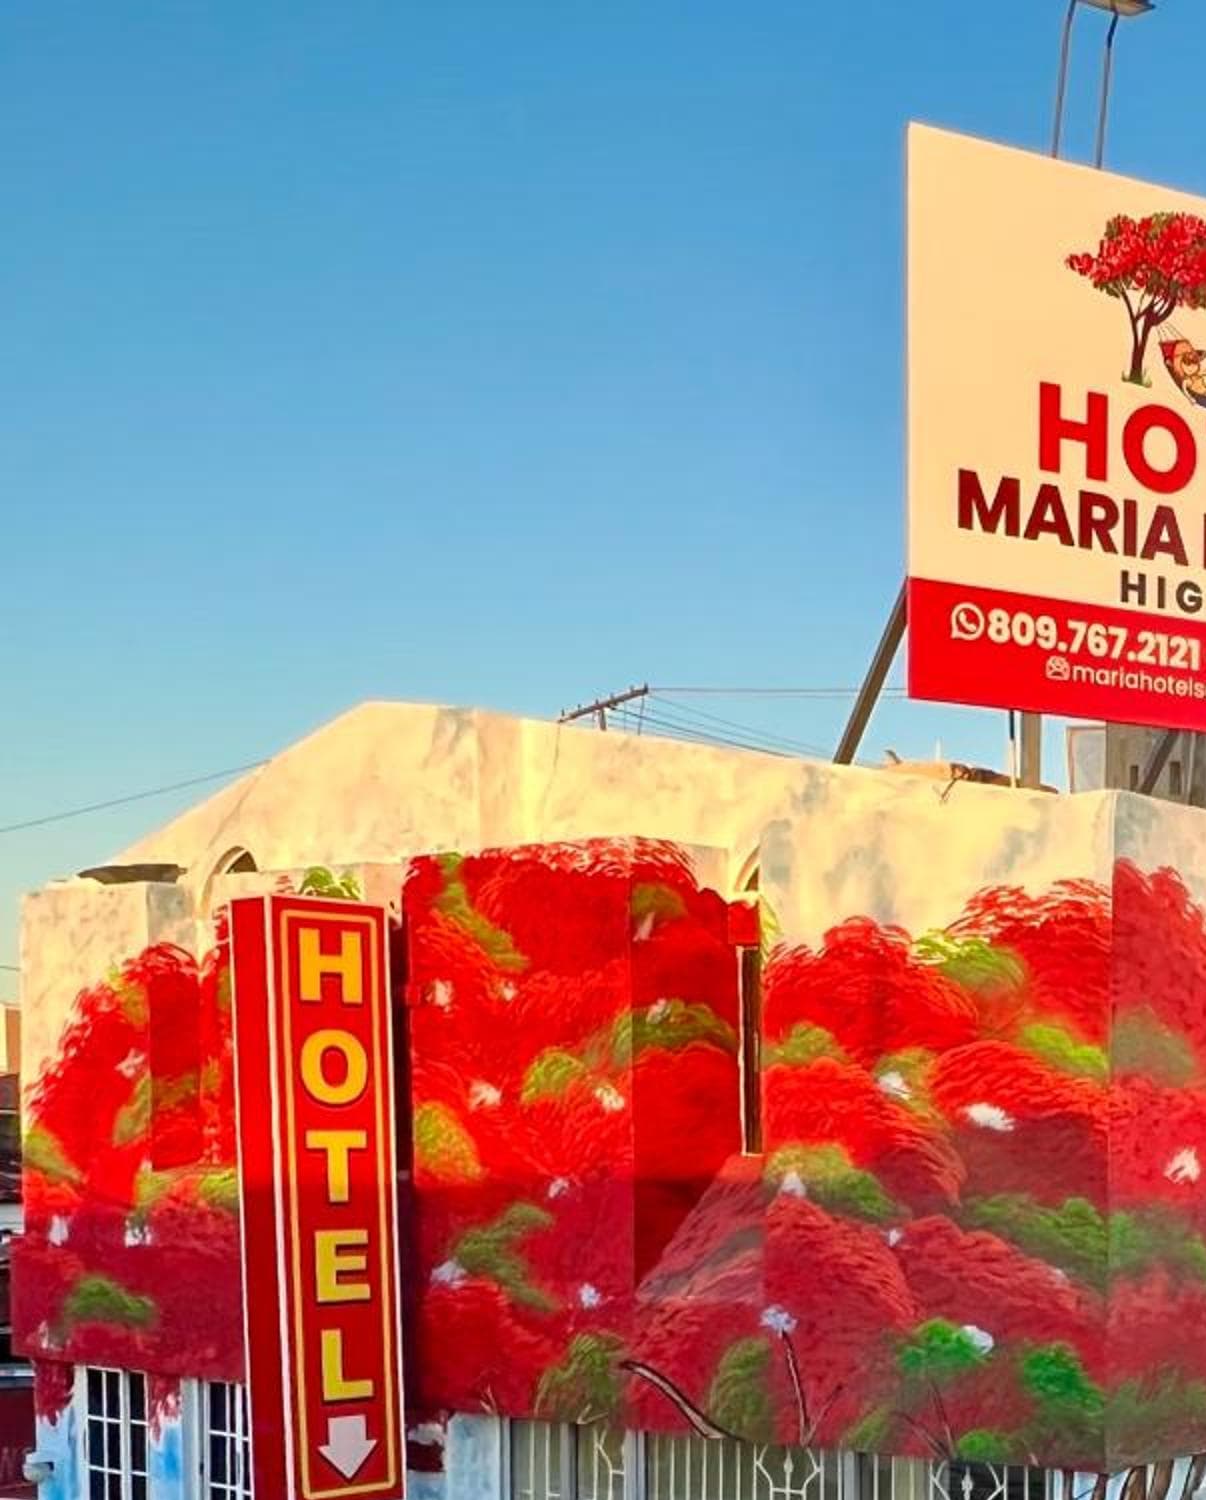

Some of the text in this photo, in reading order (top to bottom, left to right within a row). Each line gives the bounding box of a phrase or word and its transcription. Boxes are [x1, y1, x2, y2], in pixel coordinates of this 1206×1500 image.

[957, 468, 1189, 568] MARIA
[987, 608, 1201, 672] 809.767.2121
[298, 928, 374, 1402] HOTEL
